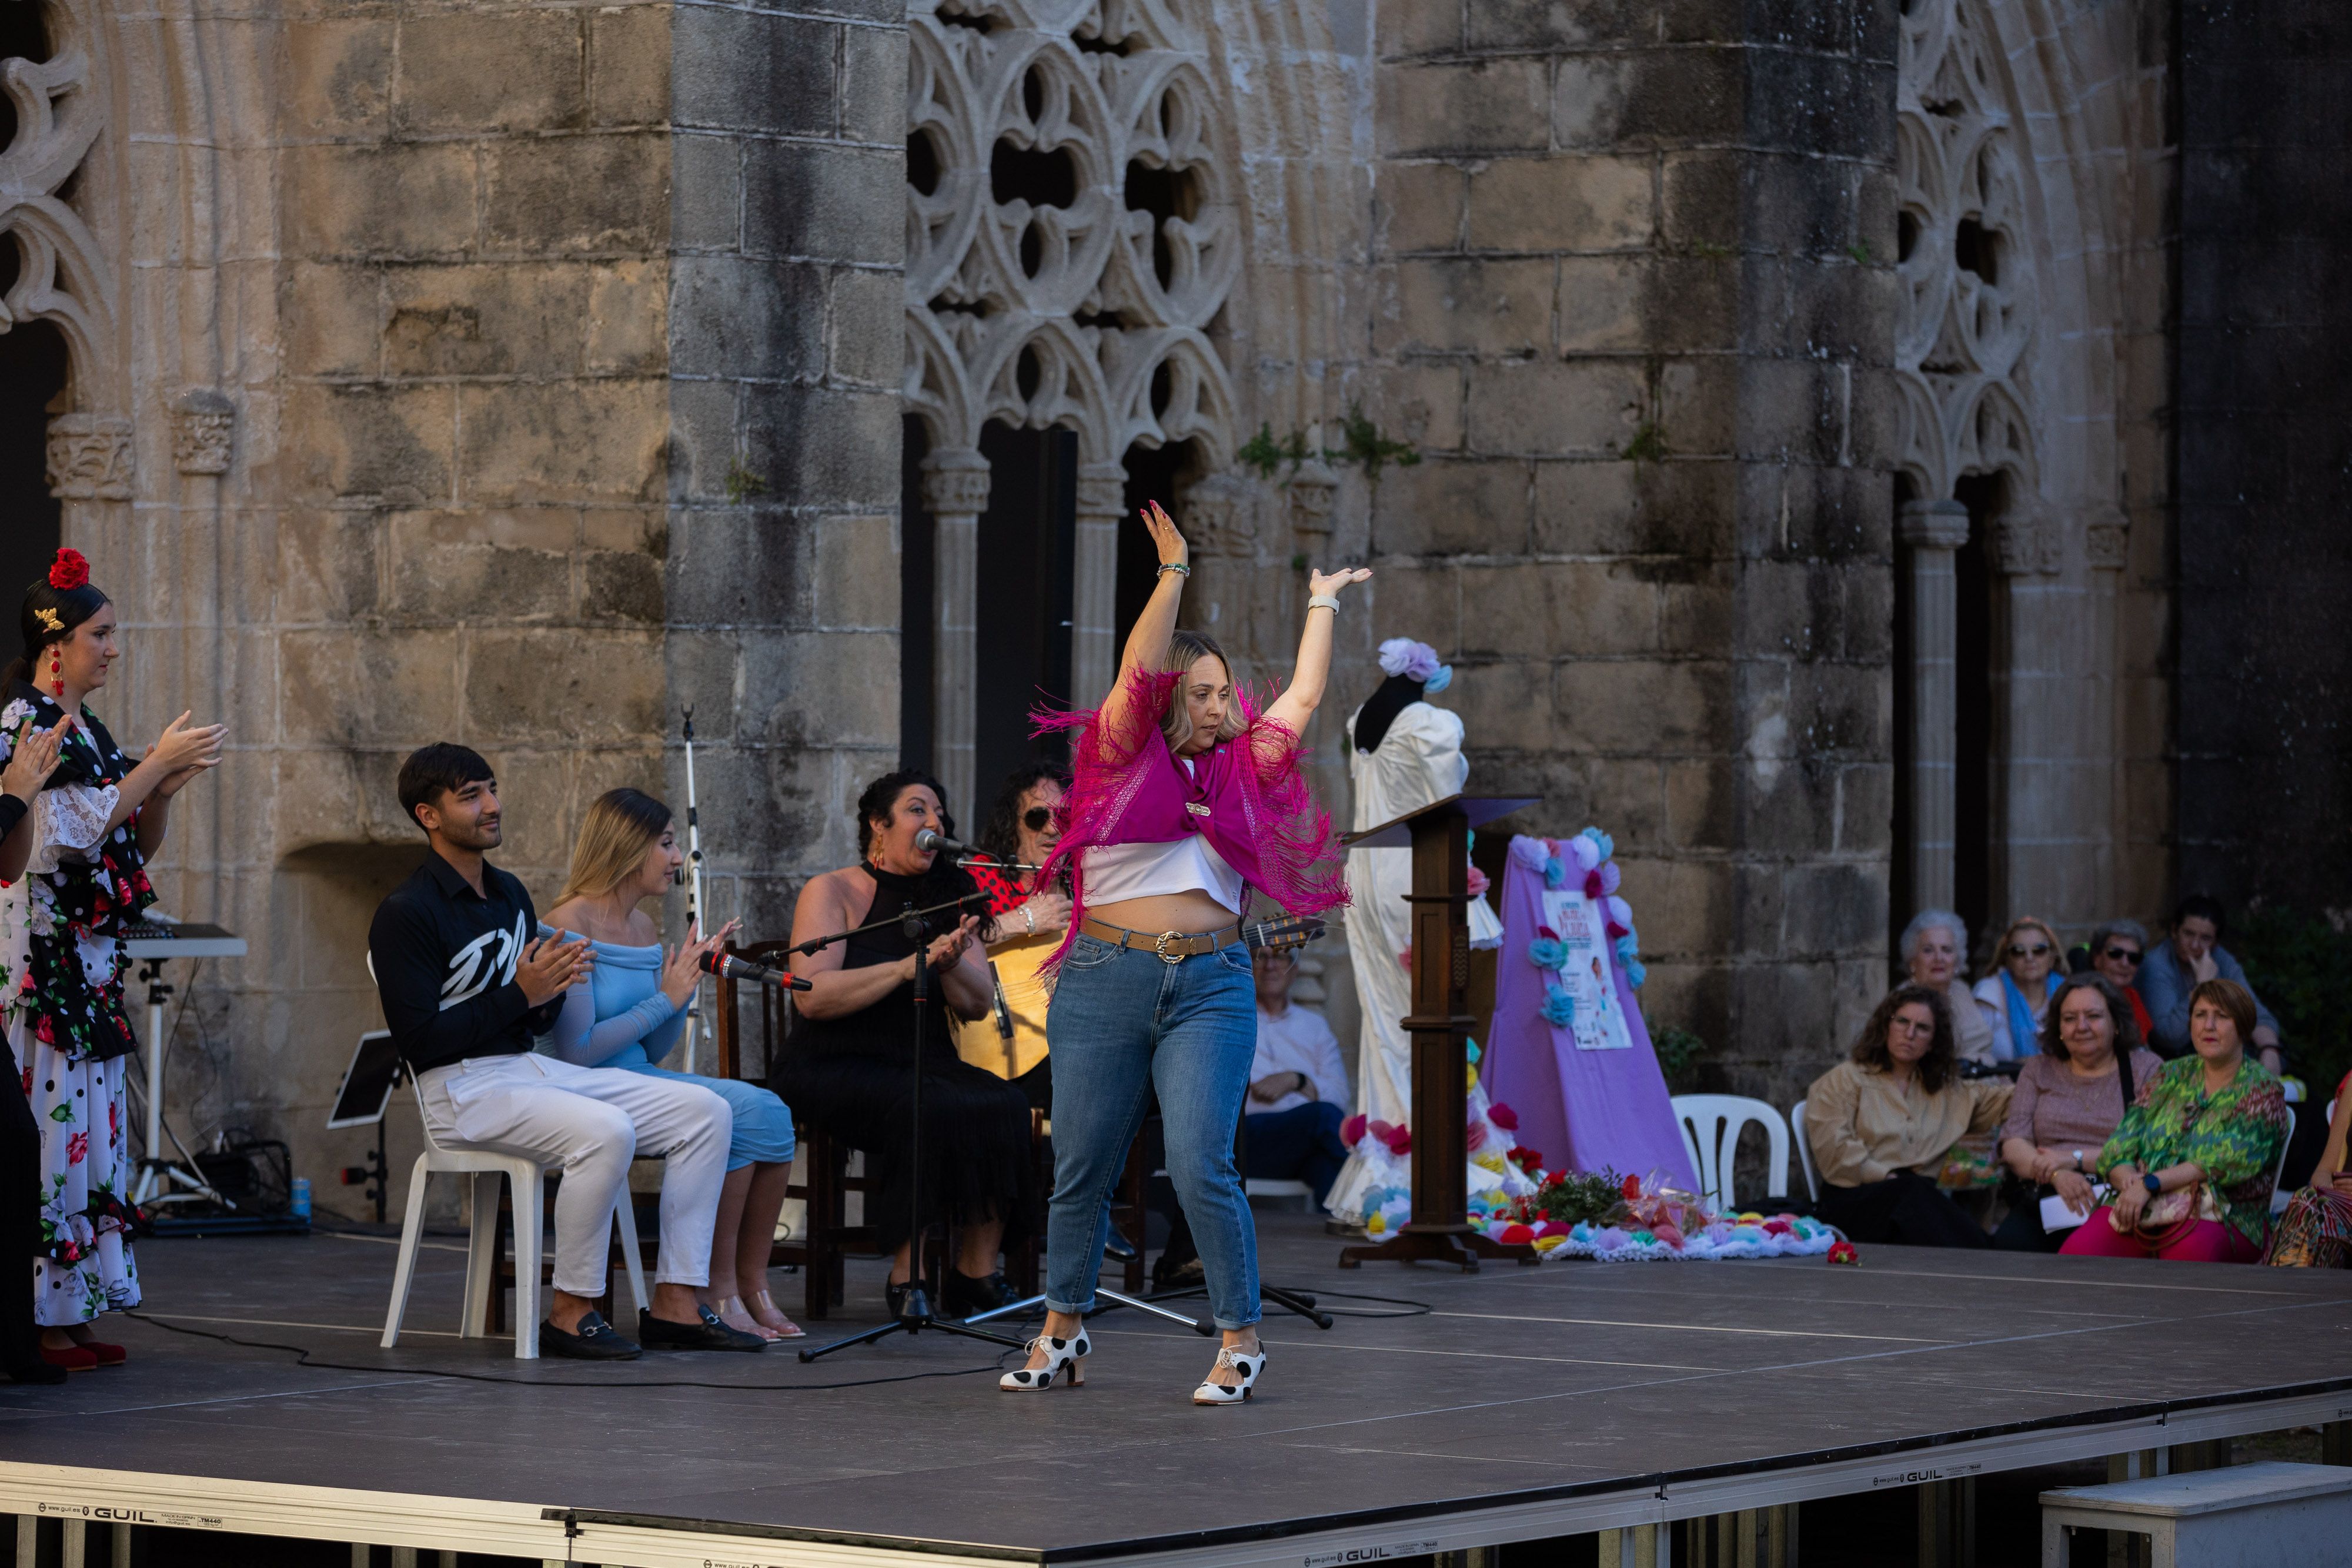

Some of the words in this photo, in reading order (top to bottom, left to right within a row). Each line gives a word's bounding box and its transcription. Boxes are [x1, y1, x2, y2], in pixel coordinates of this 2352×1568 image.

[1907, 1470, 1943, 1482] GUIL
[95, 1507, 154, 1523] GUIL
[1347, 1547, 1390, 1562] GUIL
